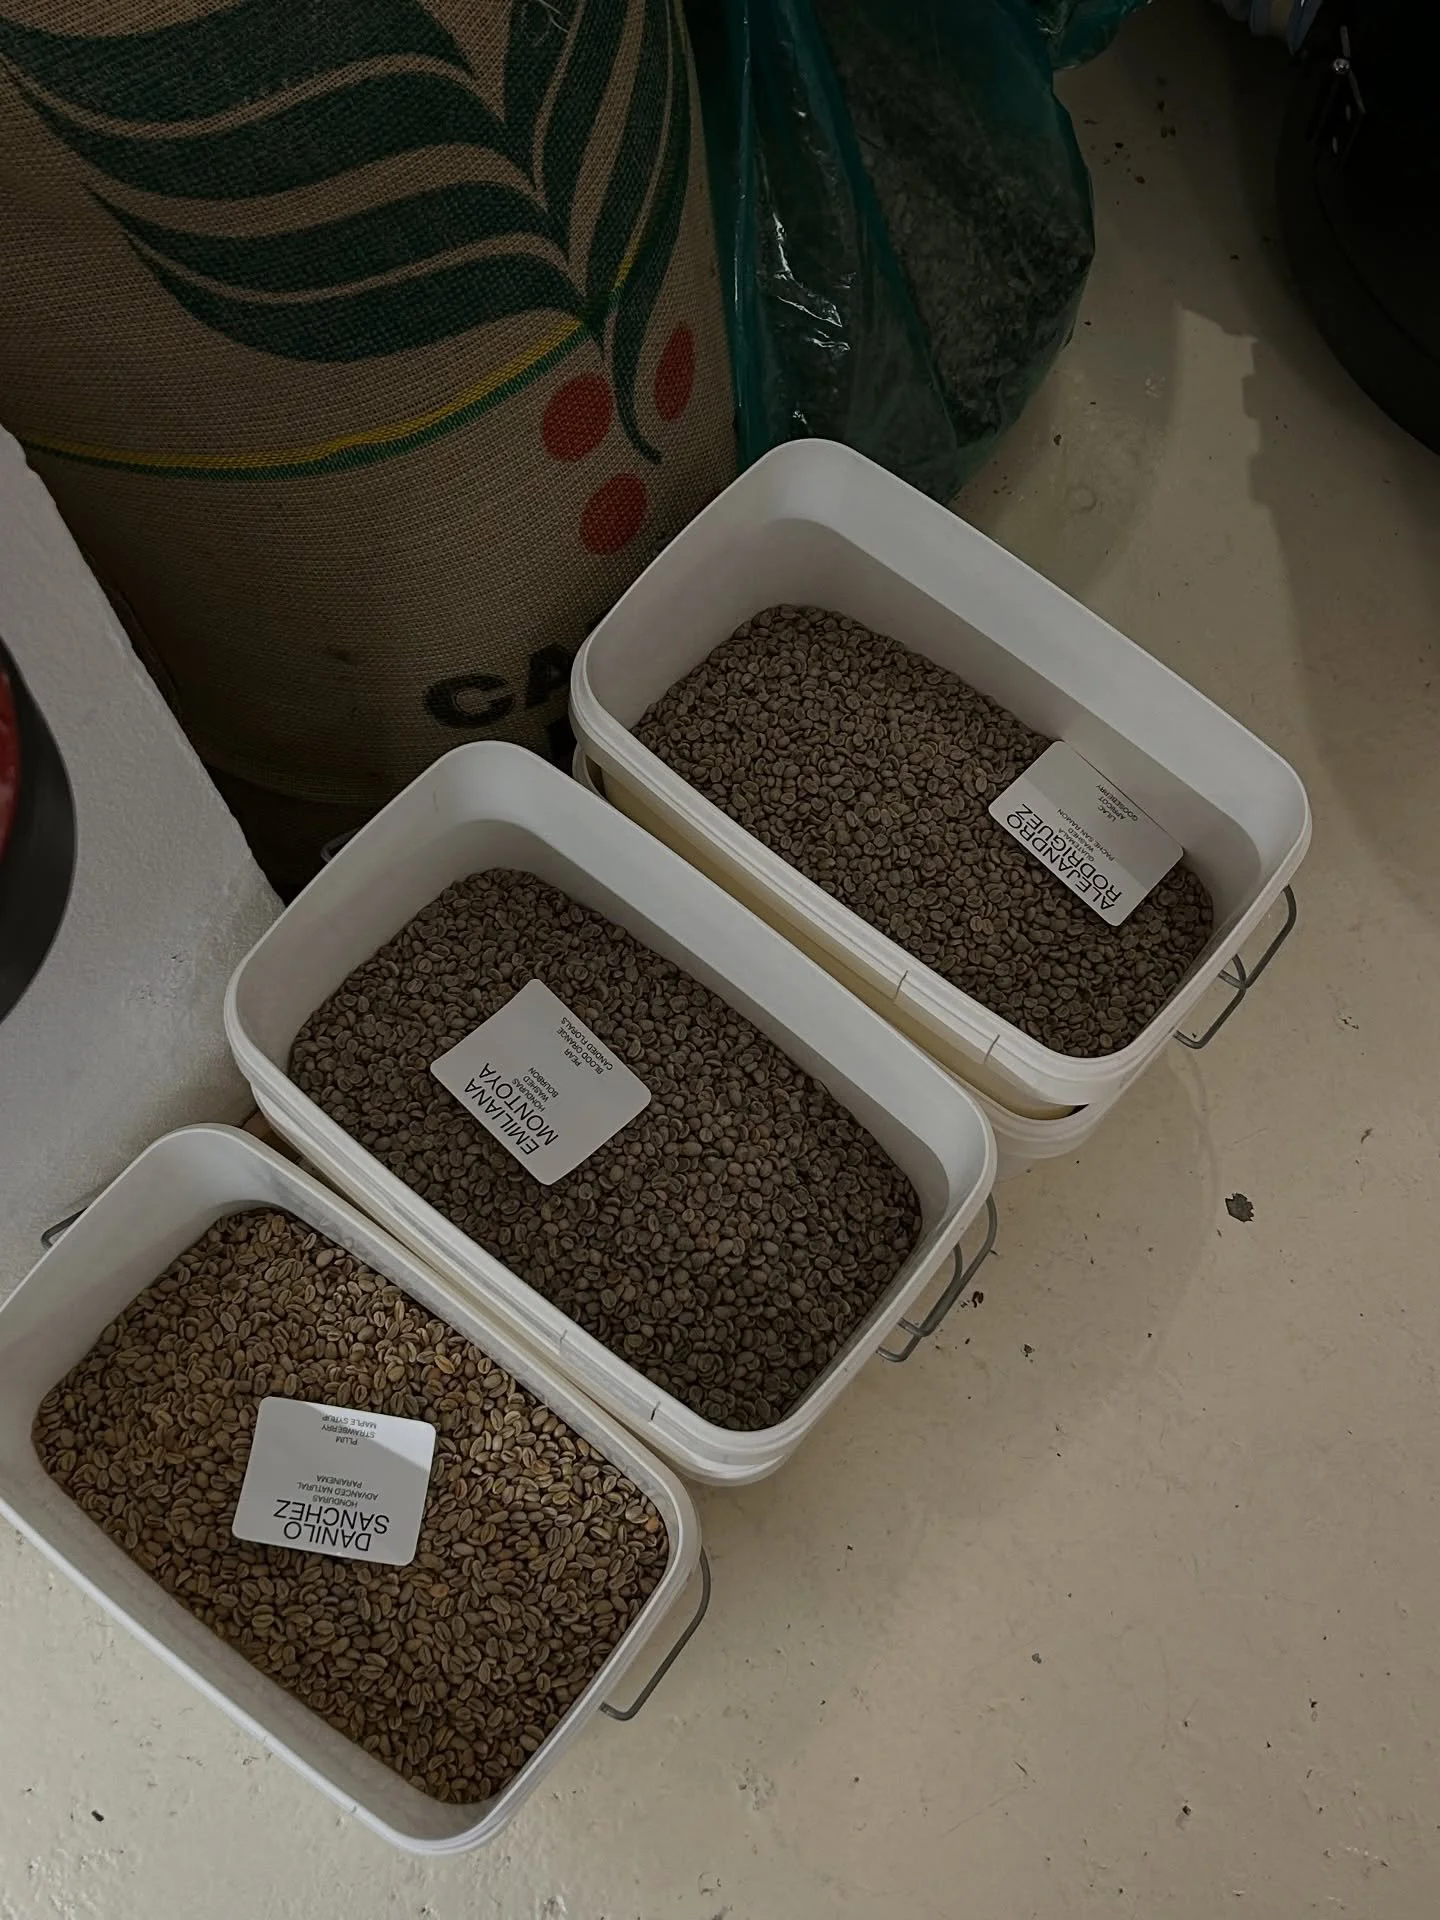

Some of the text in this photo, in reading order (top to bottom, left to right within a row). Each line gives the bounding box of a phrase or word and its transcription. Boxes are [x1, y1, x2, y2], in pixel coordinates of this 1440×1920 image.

[1095, 783, 1139, 821] GOOSEBERRY
[1096, 804, 1116, 821] LILAC
[1097, 795, 1126, 820] APRICOT
[1056, 827, 1095, 862] GUATEMALA
[1067, 826, 1095, 852] WASHED
[1079, 828, 1094, 842] SAN
[1003, 811, 1115, 912] ALEJANDRO
[1014, 802, 1122, 902] RODRIGUEZ
[1092, 840, 1115, 861] PACHE
[556, 1026, 604, 1074] BLOOD ORANGE
[560, 1016, 614, 1070] CANDIED FLORALS
[563, 1048, 582, 1066] PEAR
[510, 1077, 546, 1112] HONDURAS
[522, 1074, 549, 1101] WASHED
[527, 1066, 559, 1097] BOURBON
[462, 1077, 540, 1156] EMILIANA
[476, 1062, 559, 1146] MONTOYA
[321, 1413, 377, 1428] MAPLE SYRUP
[321, 1423, 375, 1437] STRAWBERRY
[335, 1435, 357, 1444] PLUM
[296, 1481, 378, 1499] ADVANCED NATURAL
[315, 1474, 362, 1487] PARAINEMA
[312, 1494, 358, 1507] HONDURAS
[271, 1498, 390, 1534] SANCHEZ
[282, 1520, 371, 1551] DANILO
